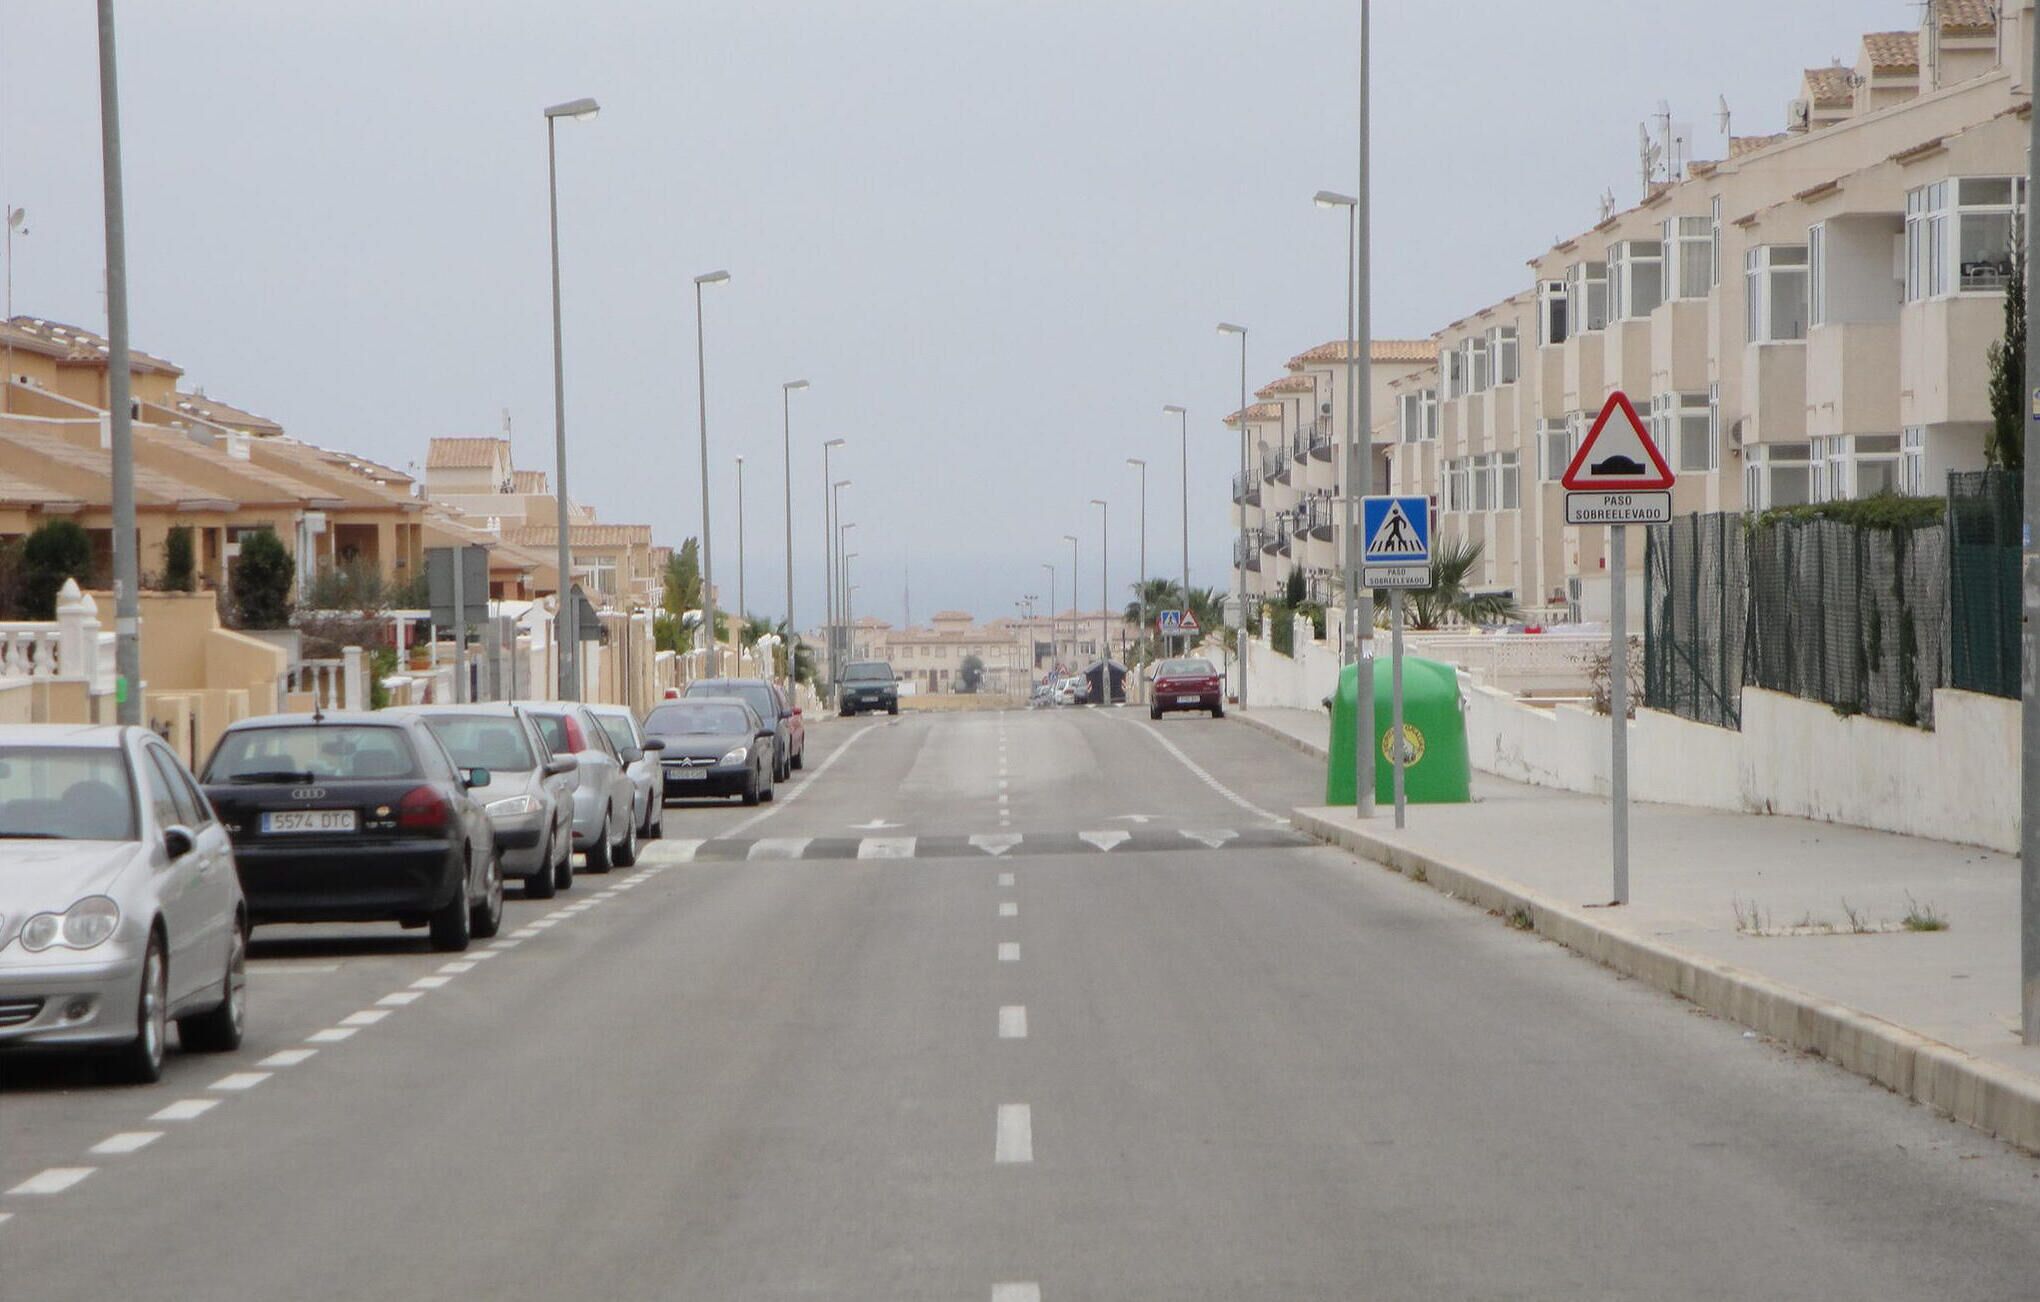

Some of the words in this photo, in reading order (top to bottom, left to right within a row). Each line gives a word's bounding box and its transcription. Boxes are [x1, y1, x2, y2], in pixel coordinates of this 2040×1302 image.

[1604, 495, 1632, 506] PASO
[1576, 508, 1661, 520] SOBREELEVADO
[1387, 568, 1406, 576] PASO
[1370, 577, 1424, 585] SOBREELEVADO
[275, 813, 313, 829] 5574
[321, 813, 351, 828] DTC
